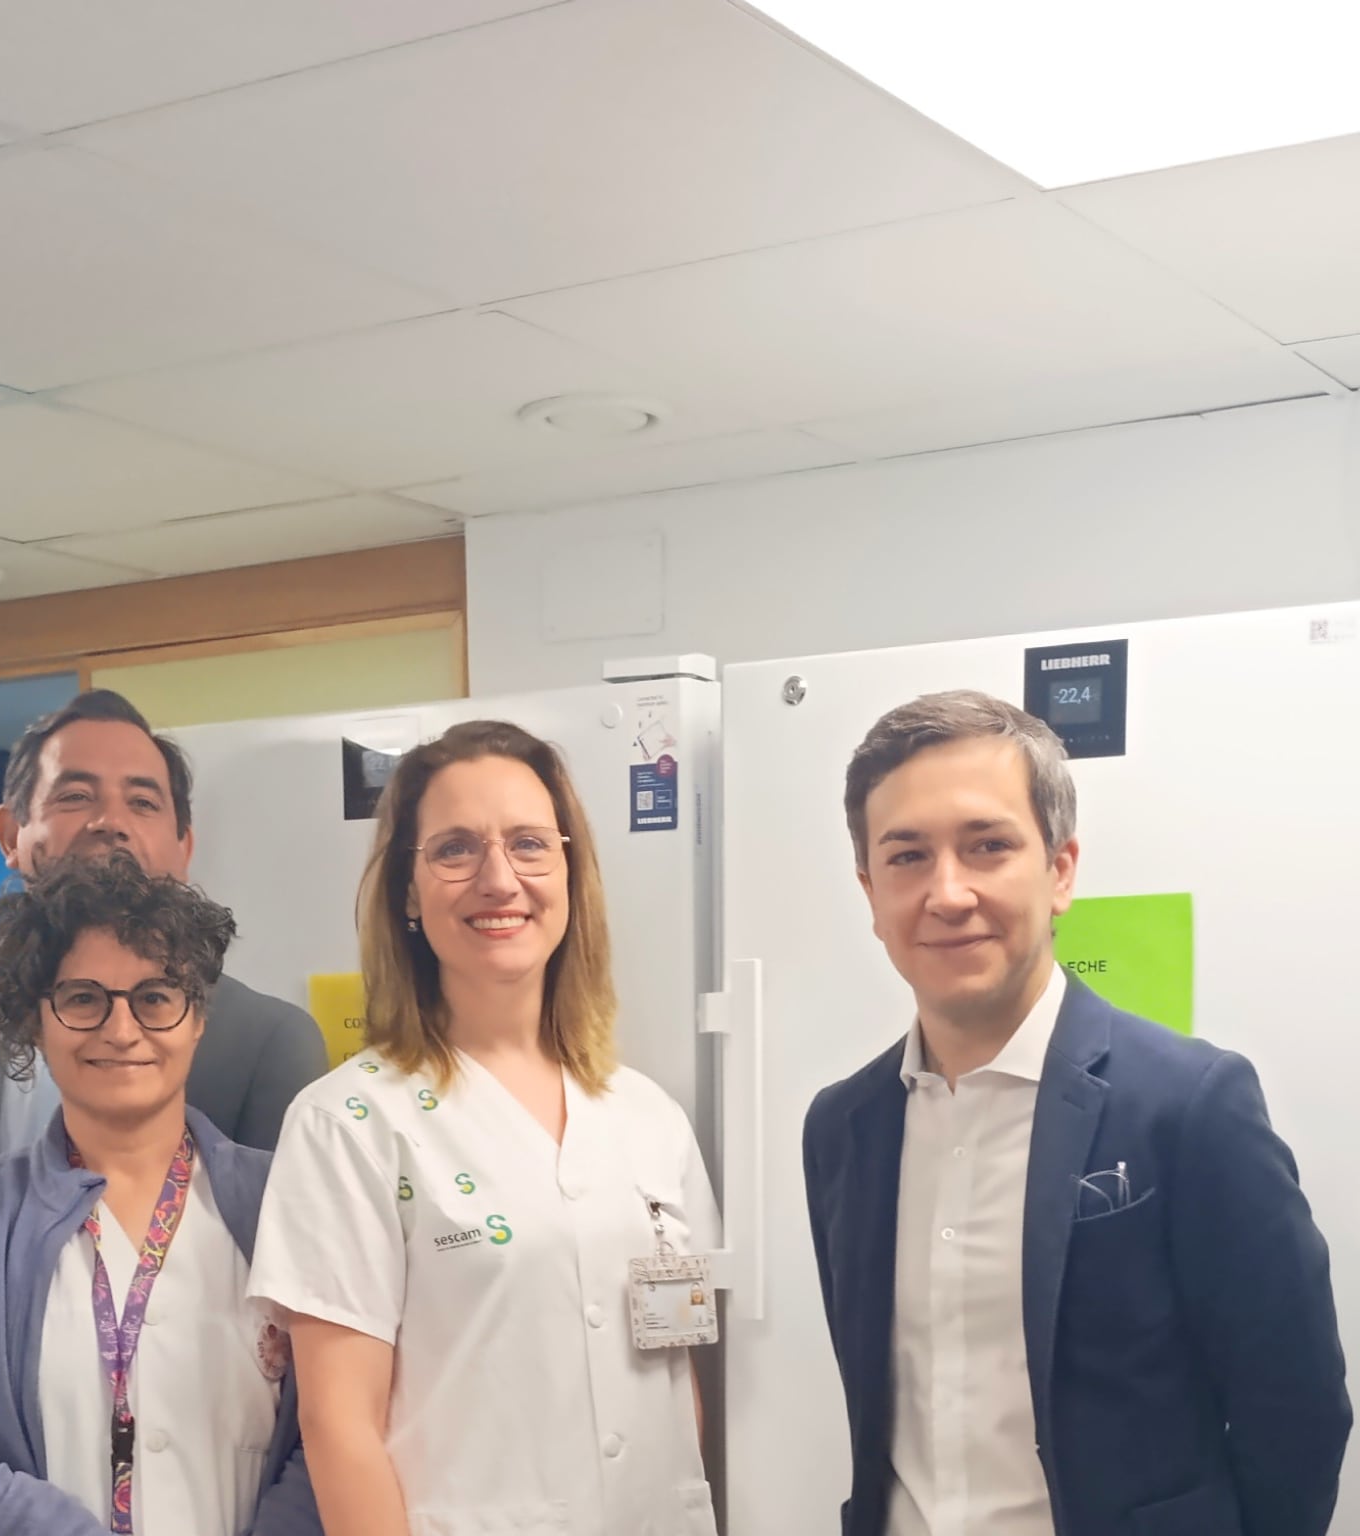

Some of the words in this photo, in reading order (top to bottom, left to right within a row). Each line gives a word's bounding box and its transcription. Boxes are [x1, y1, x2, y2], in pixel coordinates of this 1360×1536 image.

[1040, 653, 1111, 671] LIEBHERR
[1066, 959, 1108, 974] ECHE
[434, 1228, 482, 1247] sescam
